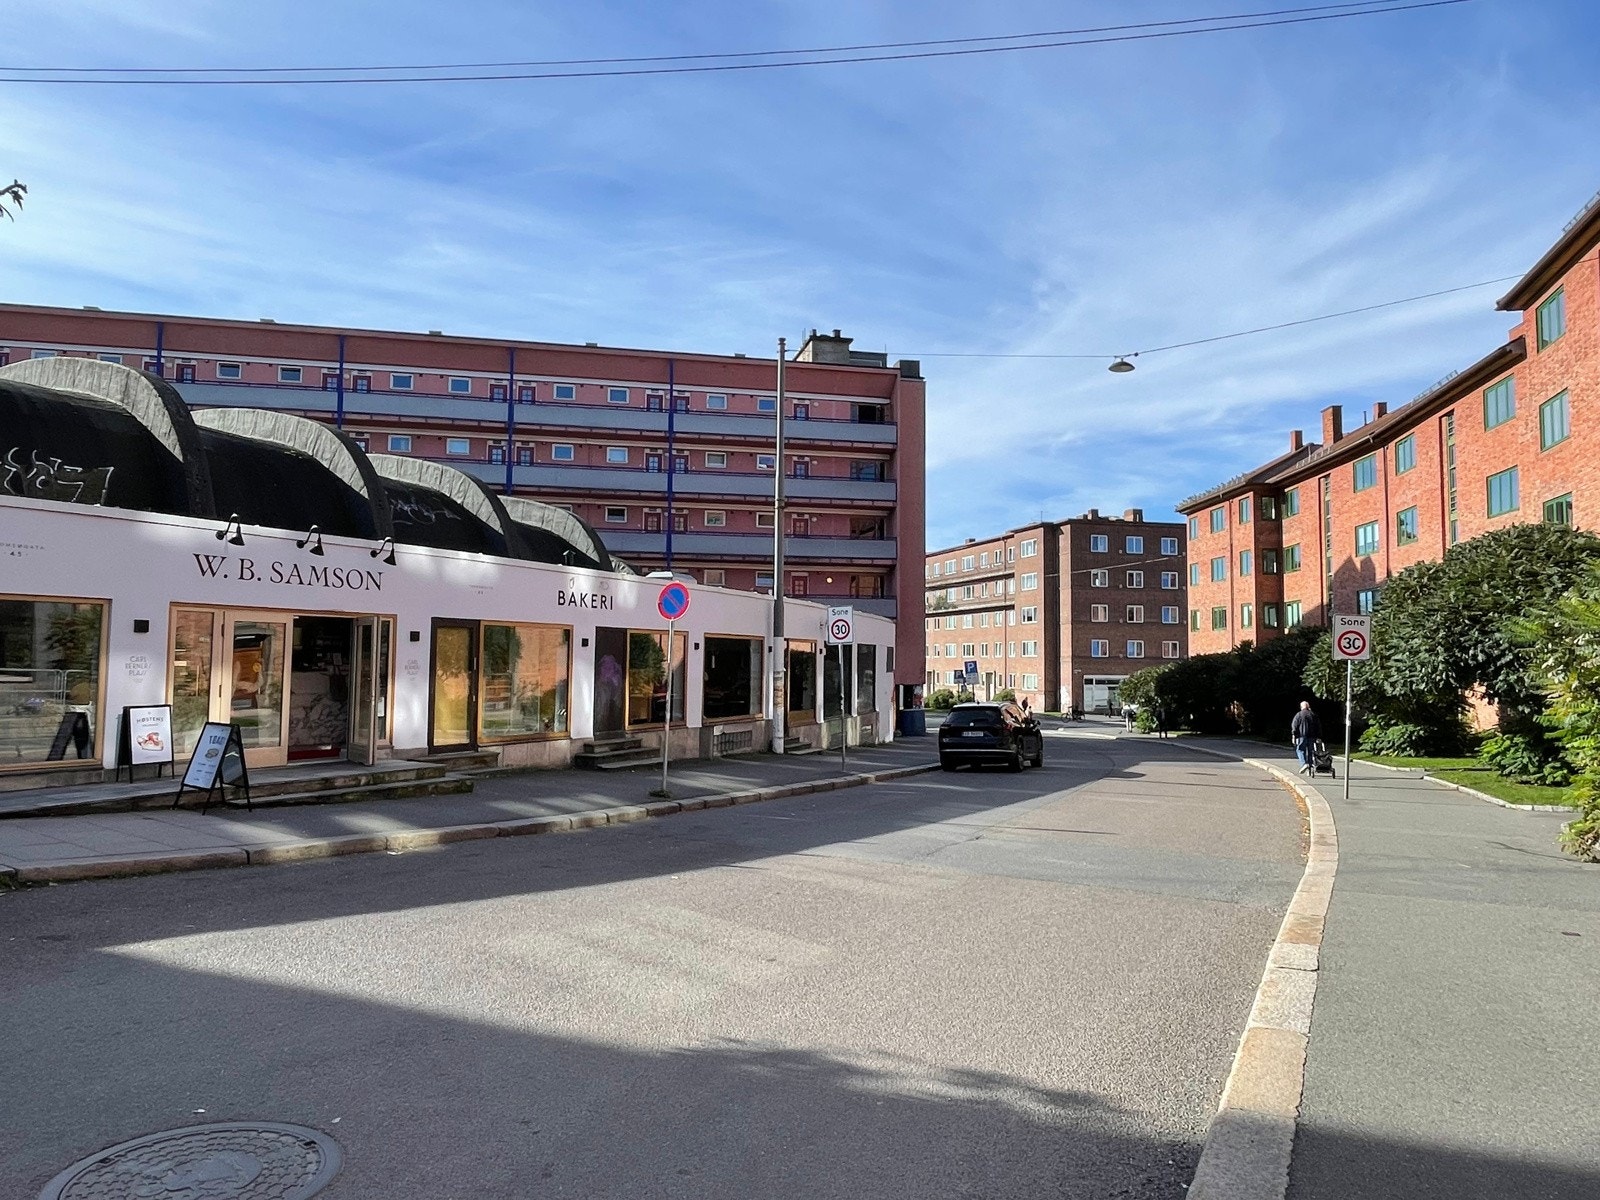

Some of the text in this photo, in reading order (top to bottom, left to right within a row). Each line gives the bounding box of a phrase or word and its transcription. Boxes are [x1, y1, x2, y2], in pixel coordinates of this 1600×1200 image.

[192, 553, 383, 591] W. B. SAMSON
[558, 590, 613, 610] BAKERI
[1340, 617, 1365, 627] Sone
[834, 624, 847, 635] 30
[967, 662, 975, 673] P
